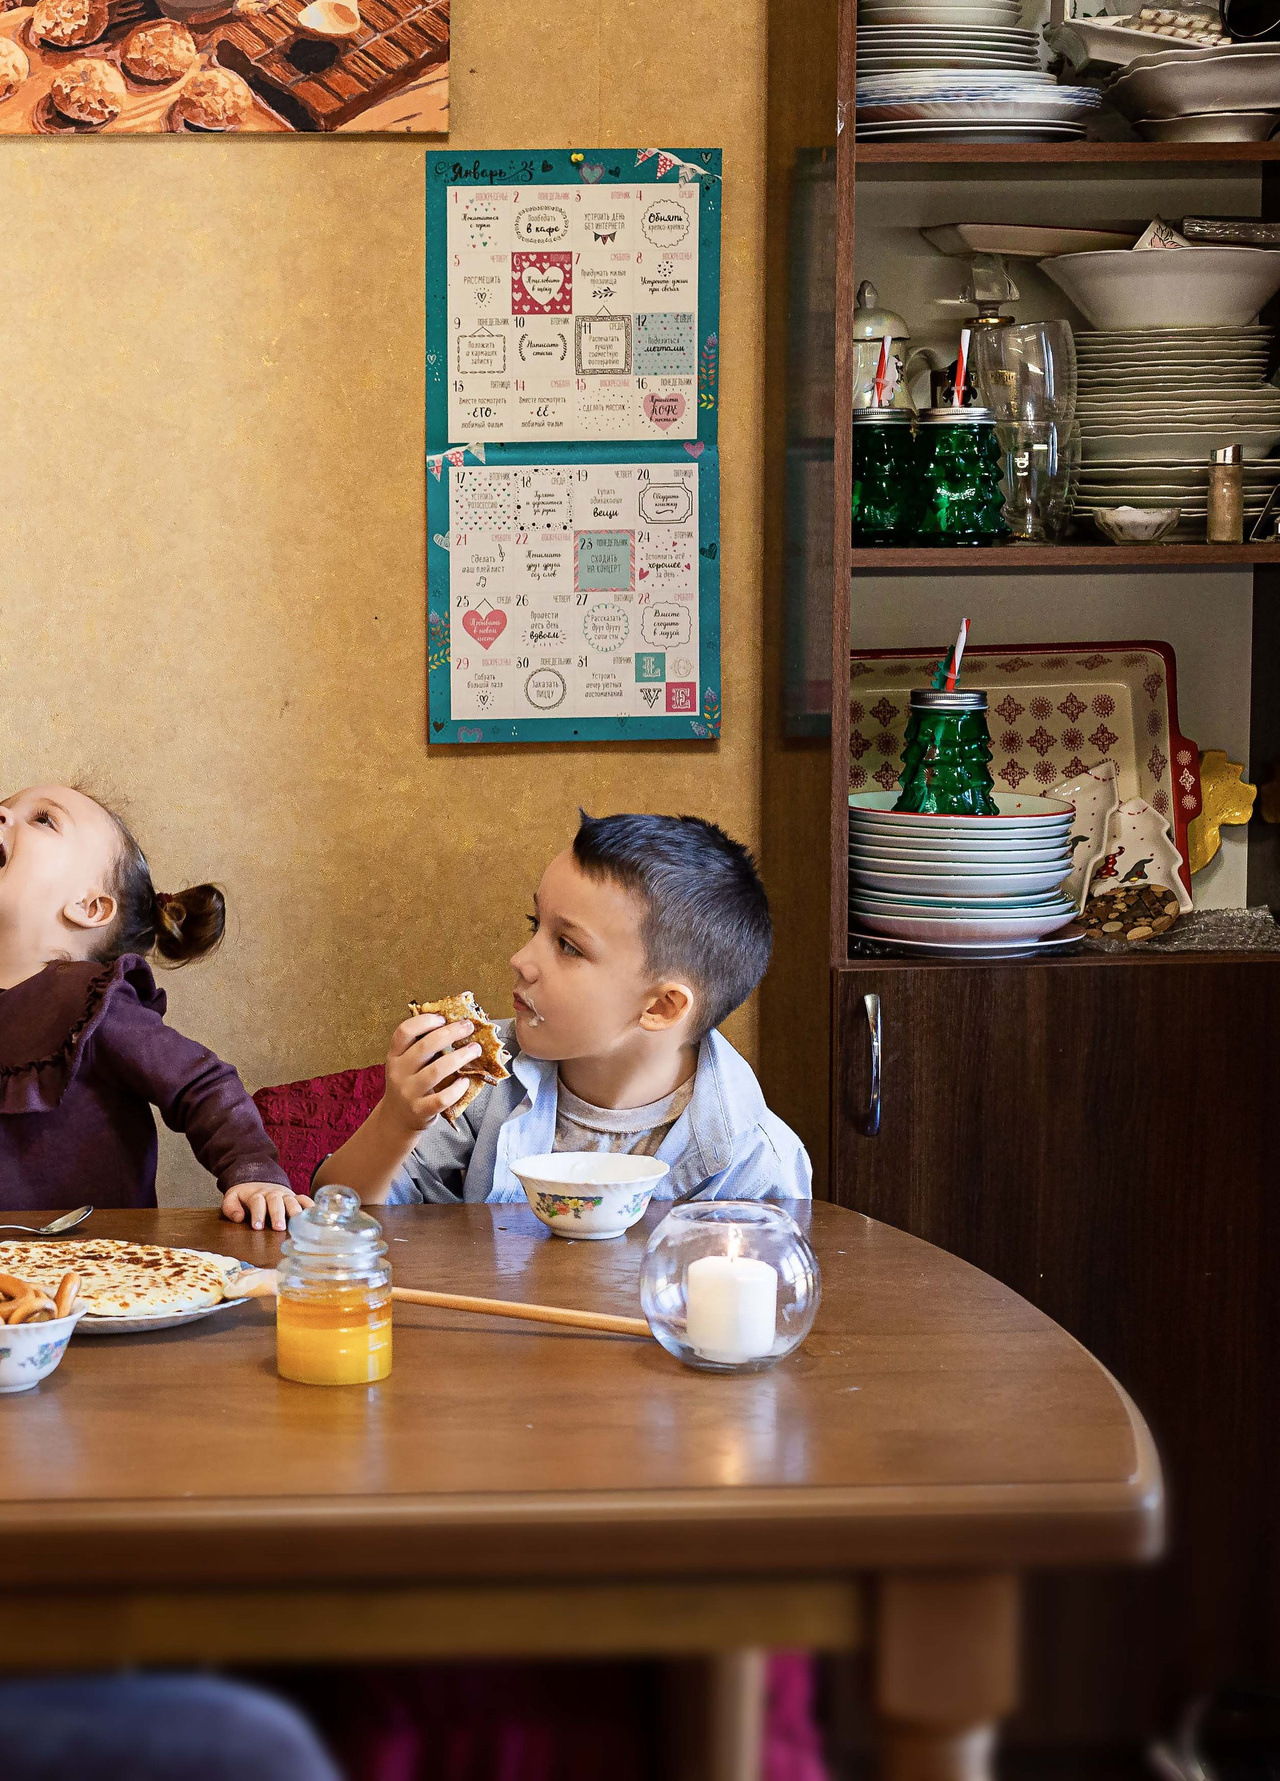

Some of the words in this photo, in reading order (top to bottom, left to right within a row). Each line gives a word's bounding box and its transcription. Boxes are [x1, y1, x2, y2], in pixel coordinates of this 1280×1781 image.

[513, 191, 520, 203] 2
[575, 190, 581, 203] 3
[648, 212, 683, 223] Обнять
[535, 225, 560, 237] кафе
[454, 254, 460, 267] 5
[513, 253, 521, 267] 6
[575, 253, 580, 265] 7
[636, 252, 643, 264] 8
[453, 316, 461, 330] 9
[513, 316, 525, 328] 10
[636, 314, 647, 327] 12
[582, 322, 591, 334] 11
[452, 380, 464, 393] 13
[514, 379, 525, 391] 14
[575, 378, 587, 391] 15
[636, 377, 648, 390] 16
[455, 471, 466, 484] 17
[575, 470, 588, 482] 19
[637, 468, 650, 481] 20
[520, 476, 532, 488] 18
[455, 533, 467, 546] 21
[515, 532, 529, 545] 22
[637, 530, 650, 543] 24
[579, 537, 593, 550] 23
[456, 595, 470, 608] 25
[515, 594, 529, 607] 26
[575, 593, 588, 606] 27
[638, 592, 650, 605] 28
[455, 657, 469, 670] 29
[515, 656, 529, 669] 30
[577, 655, 588, 668] 31
